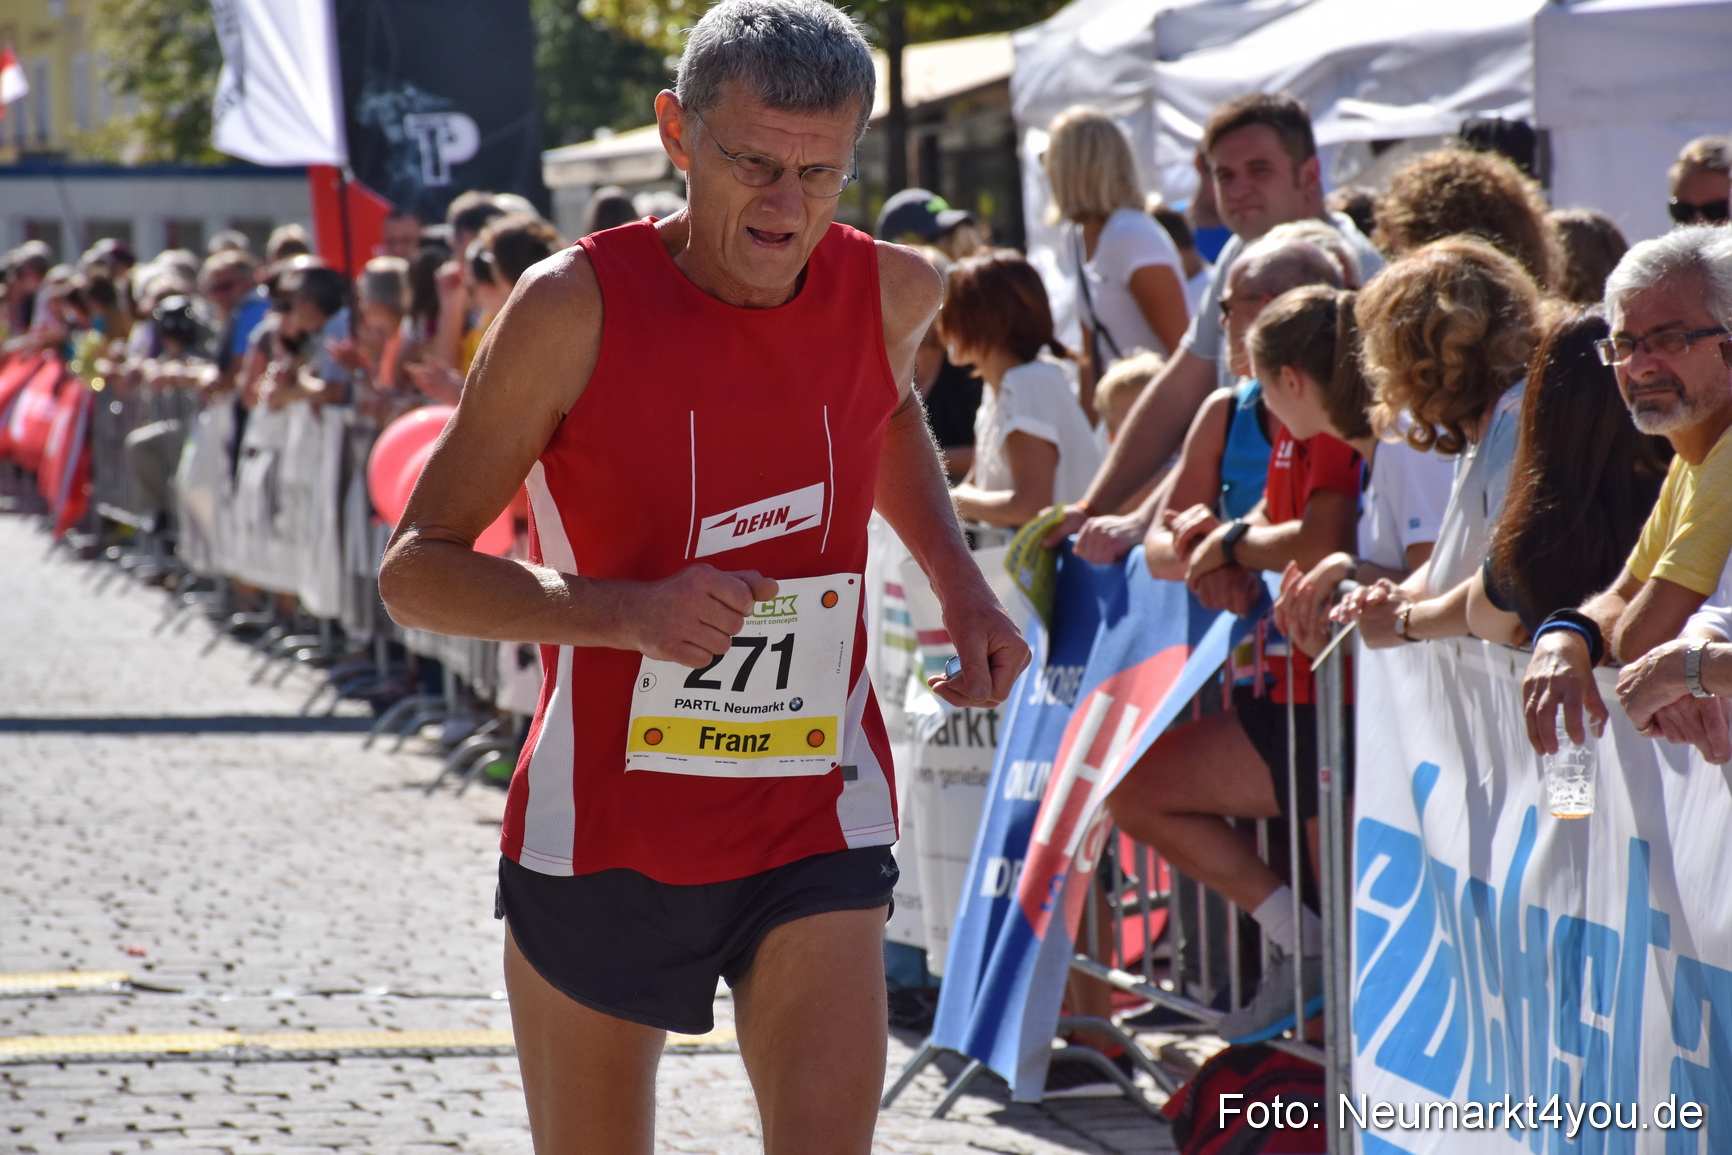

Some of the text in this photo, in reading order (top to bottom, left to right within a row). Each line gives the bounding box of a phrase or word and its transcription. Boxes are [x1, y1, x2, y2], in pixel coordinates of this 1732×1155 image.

[732, 505, 791, 537] DEHN
[752, 595, 799, 618] CK
[768, 616, 798, 626] concepts
[683, 633, 795, 692] 271
[674, 698, 785, 714] PARTL Neumarkt
[699, 726, 771, 753] Franz
